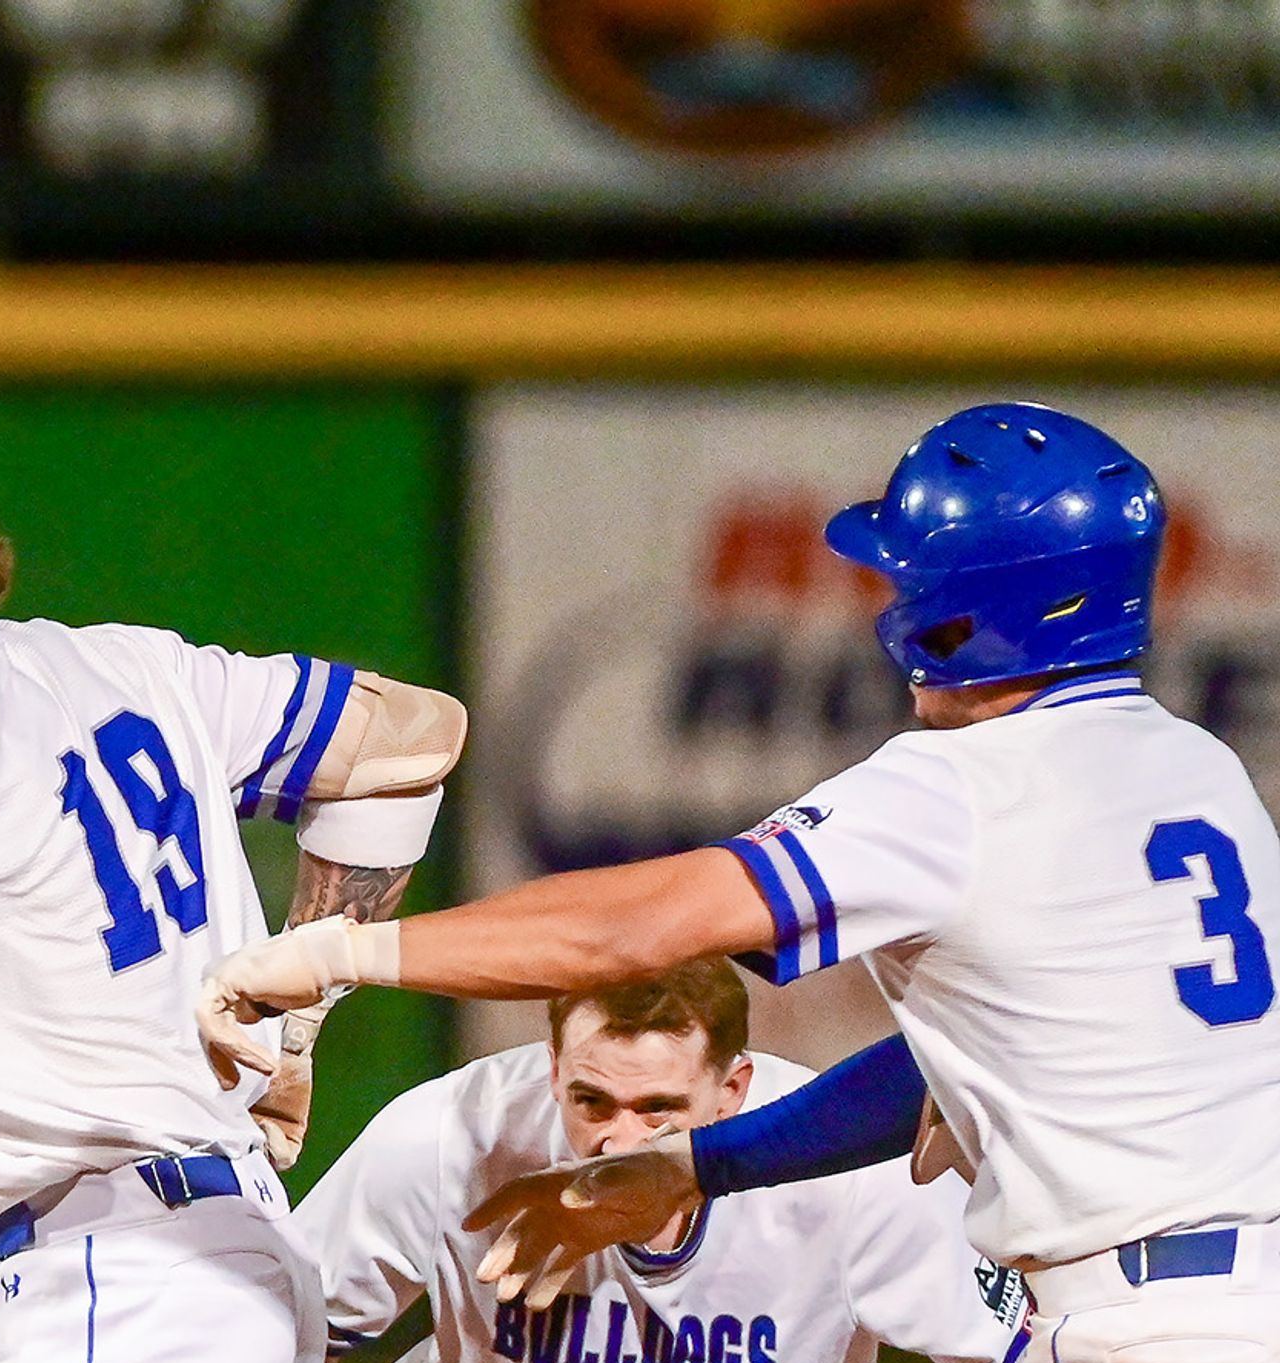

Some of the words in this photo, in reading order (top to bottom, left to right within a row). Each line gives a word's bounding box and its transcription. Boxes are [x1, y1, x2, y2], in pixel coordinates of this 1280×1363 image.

[1125, 495, 1147, 521] 3
[55, 706, 210, 976] 19
[1141, 815, 1278, 1031] 3
